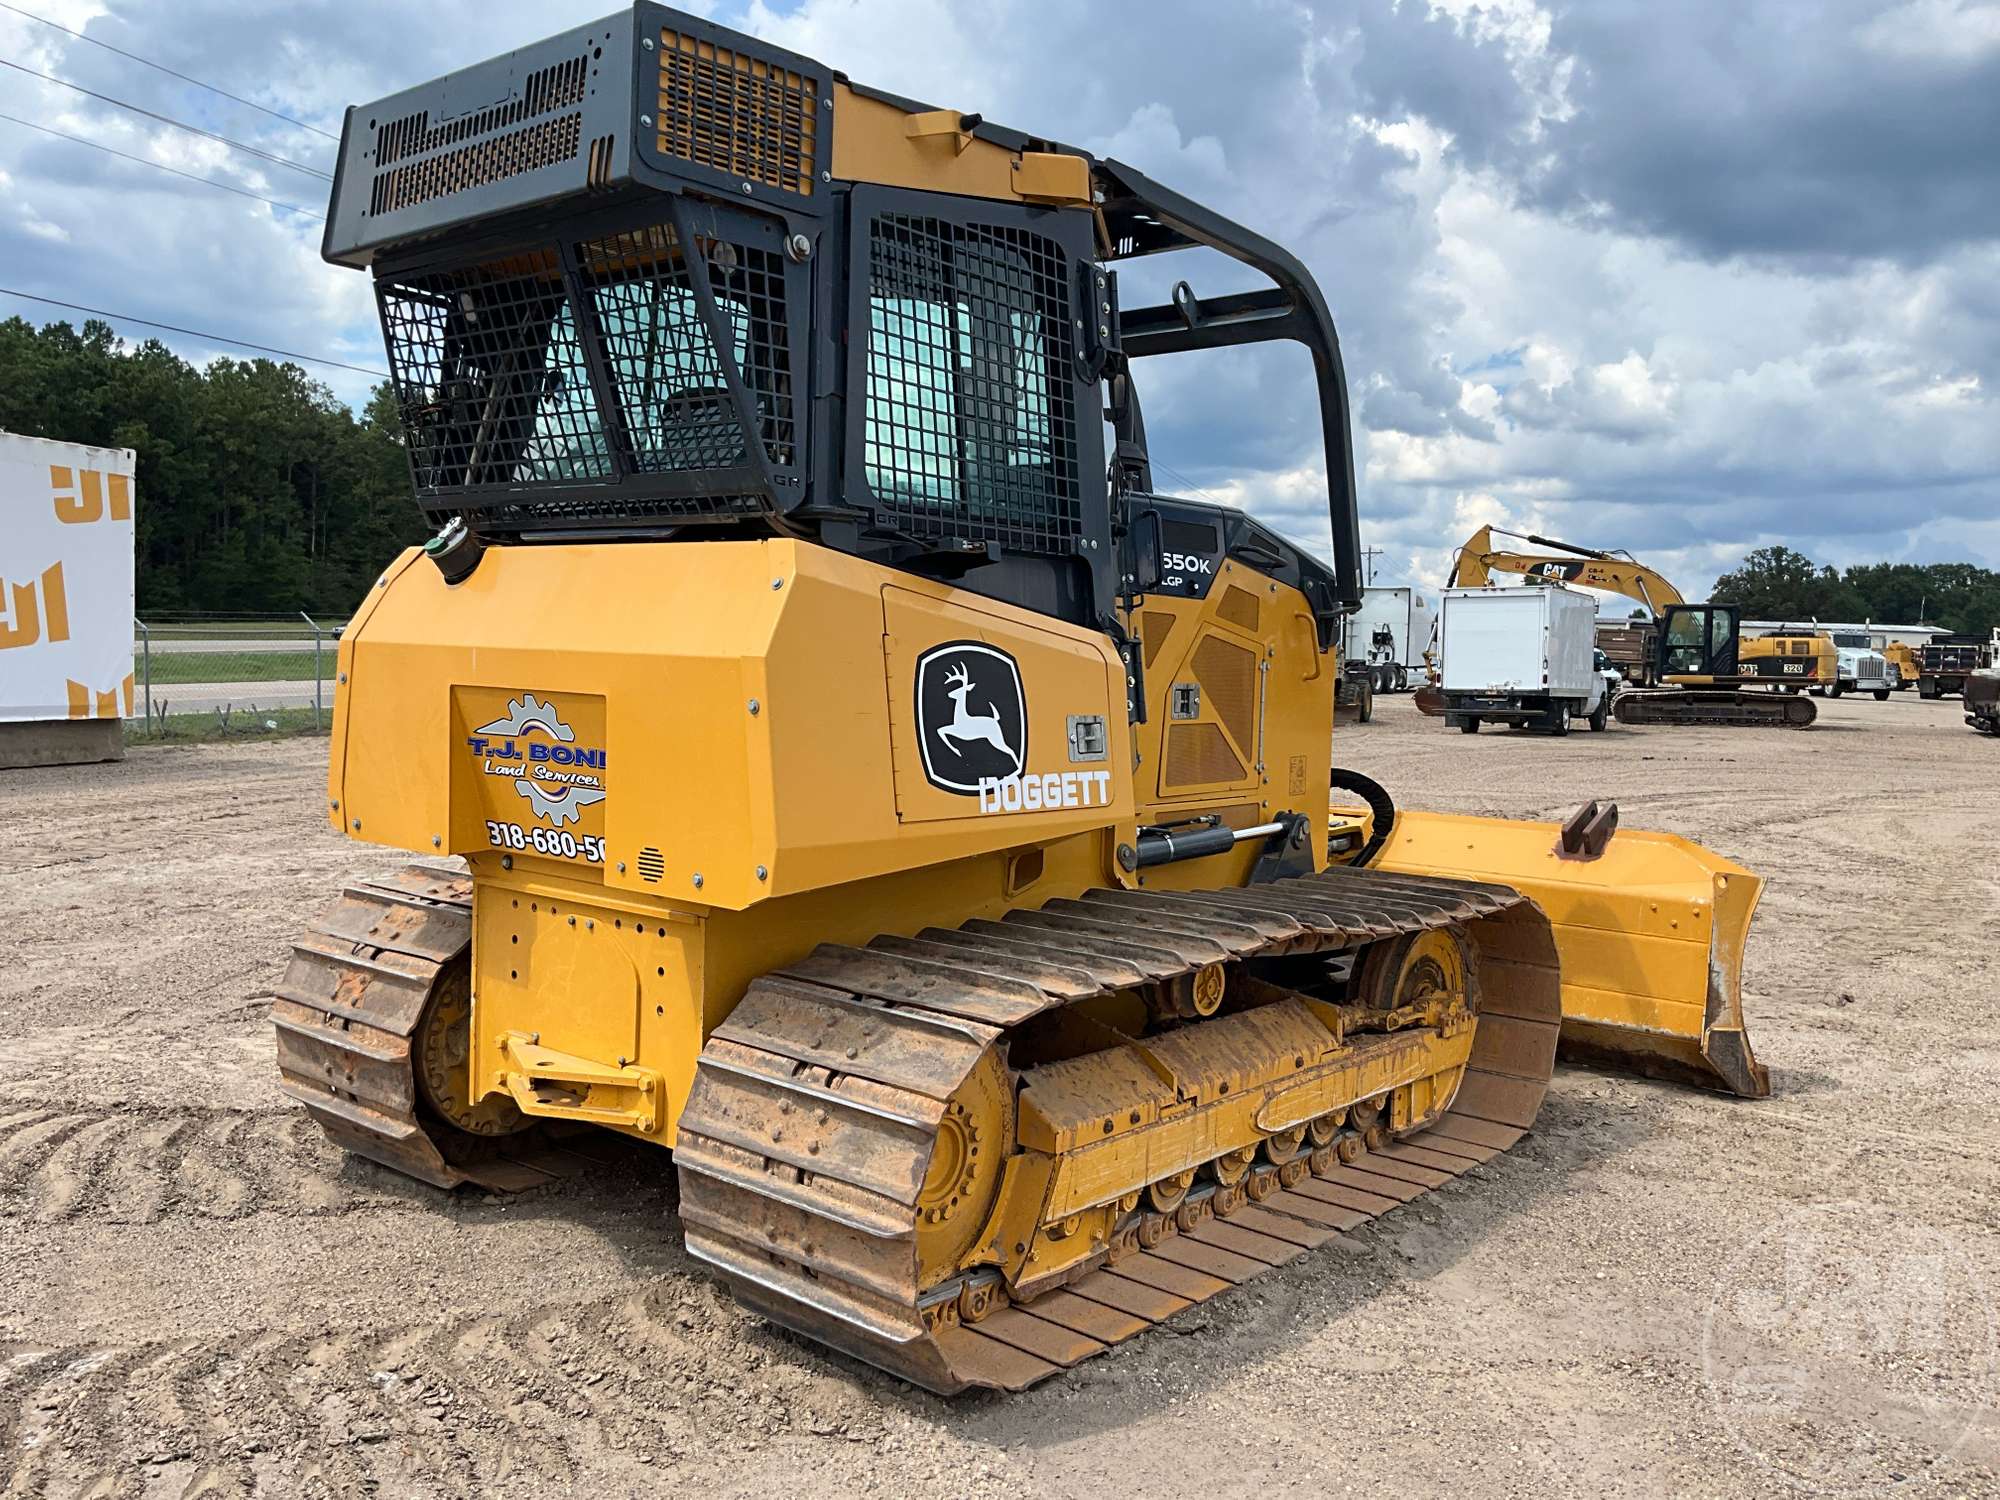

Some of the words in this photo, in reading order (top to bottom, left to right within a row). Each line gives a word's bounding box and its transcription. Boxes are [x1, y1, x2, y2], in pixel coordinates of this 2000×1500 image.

[1543, 563, 1567, 580] CAT
[1739, 664, 1758, 676] CAT
[467, 738, 523, 760] T.J.
[484, 759, 526, 777] Land
[531, 764, 600, 786] Services
[978, 770, 1110, 813] DOGGETT
